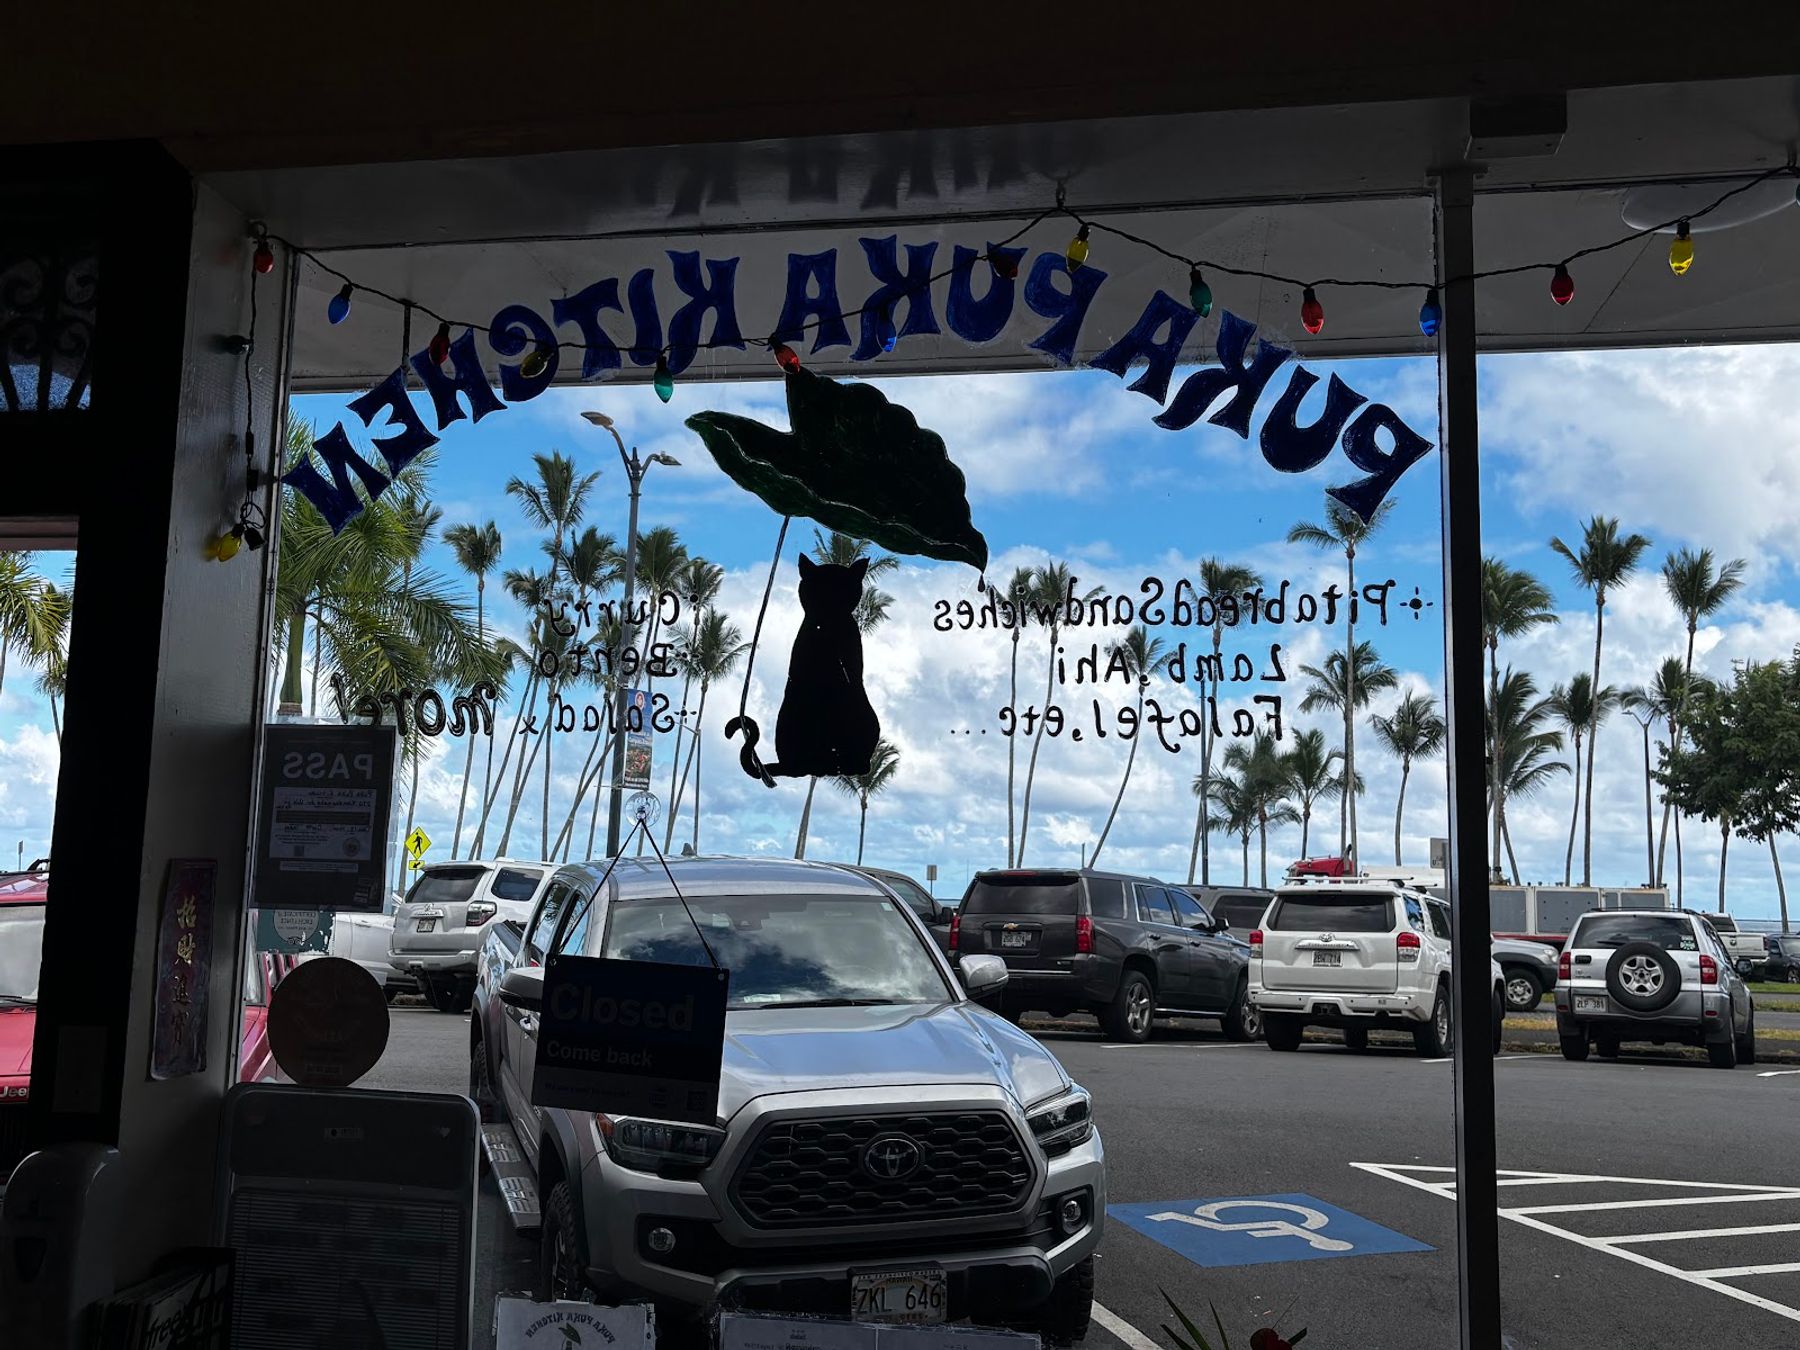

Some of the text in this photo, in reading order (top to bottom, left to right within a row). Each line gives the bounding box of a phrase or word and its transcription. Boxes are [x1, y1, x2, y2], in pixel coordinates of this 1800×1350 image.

[551, 982, 696, 1032] Closed
[545, 1040, 654, 1068] Come back
[0, 1086, 30, 1099] Jee
[857, 1283, 941, 1313] ZKL 646
